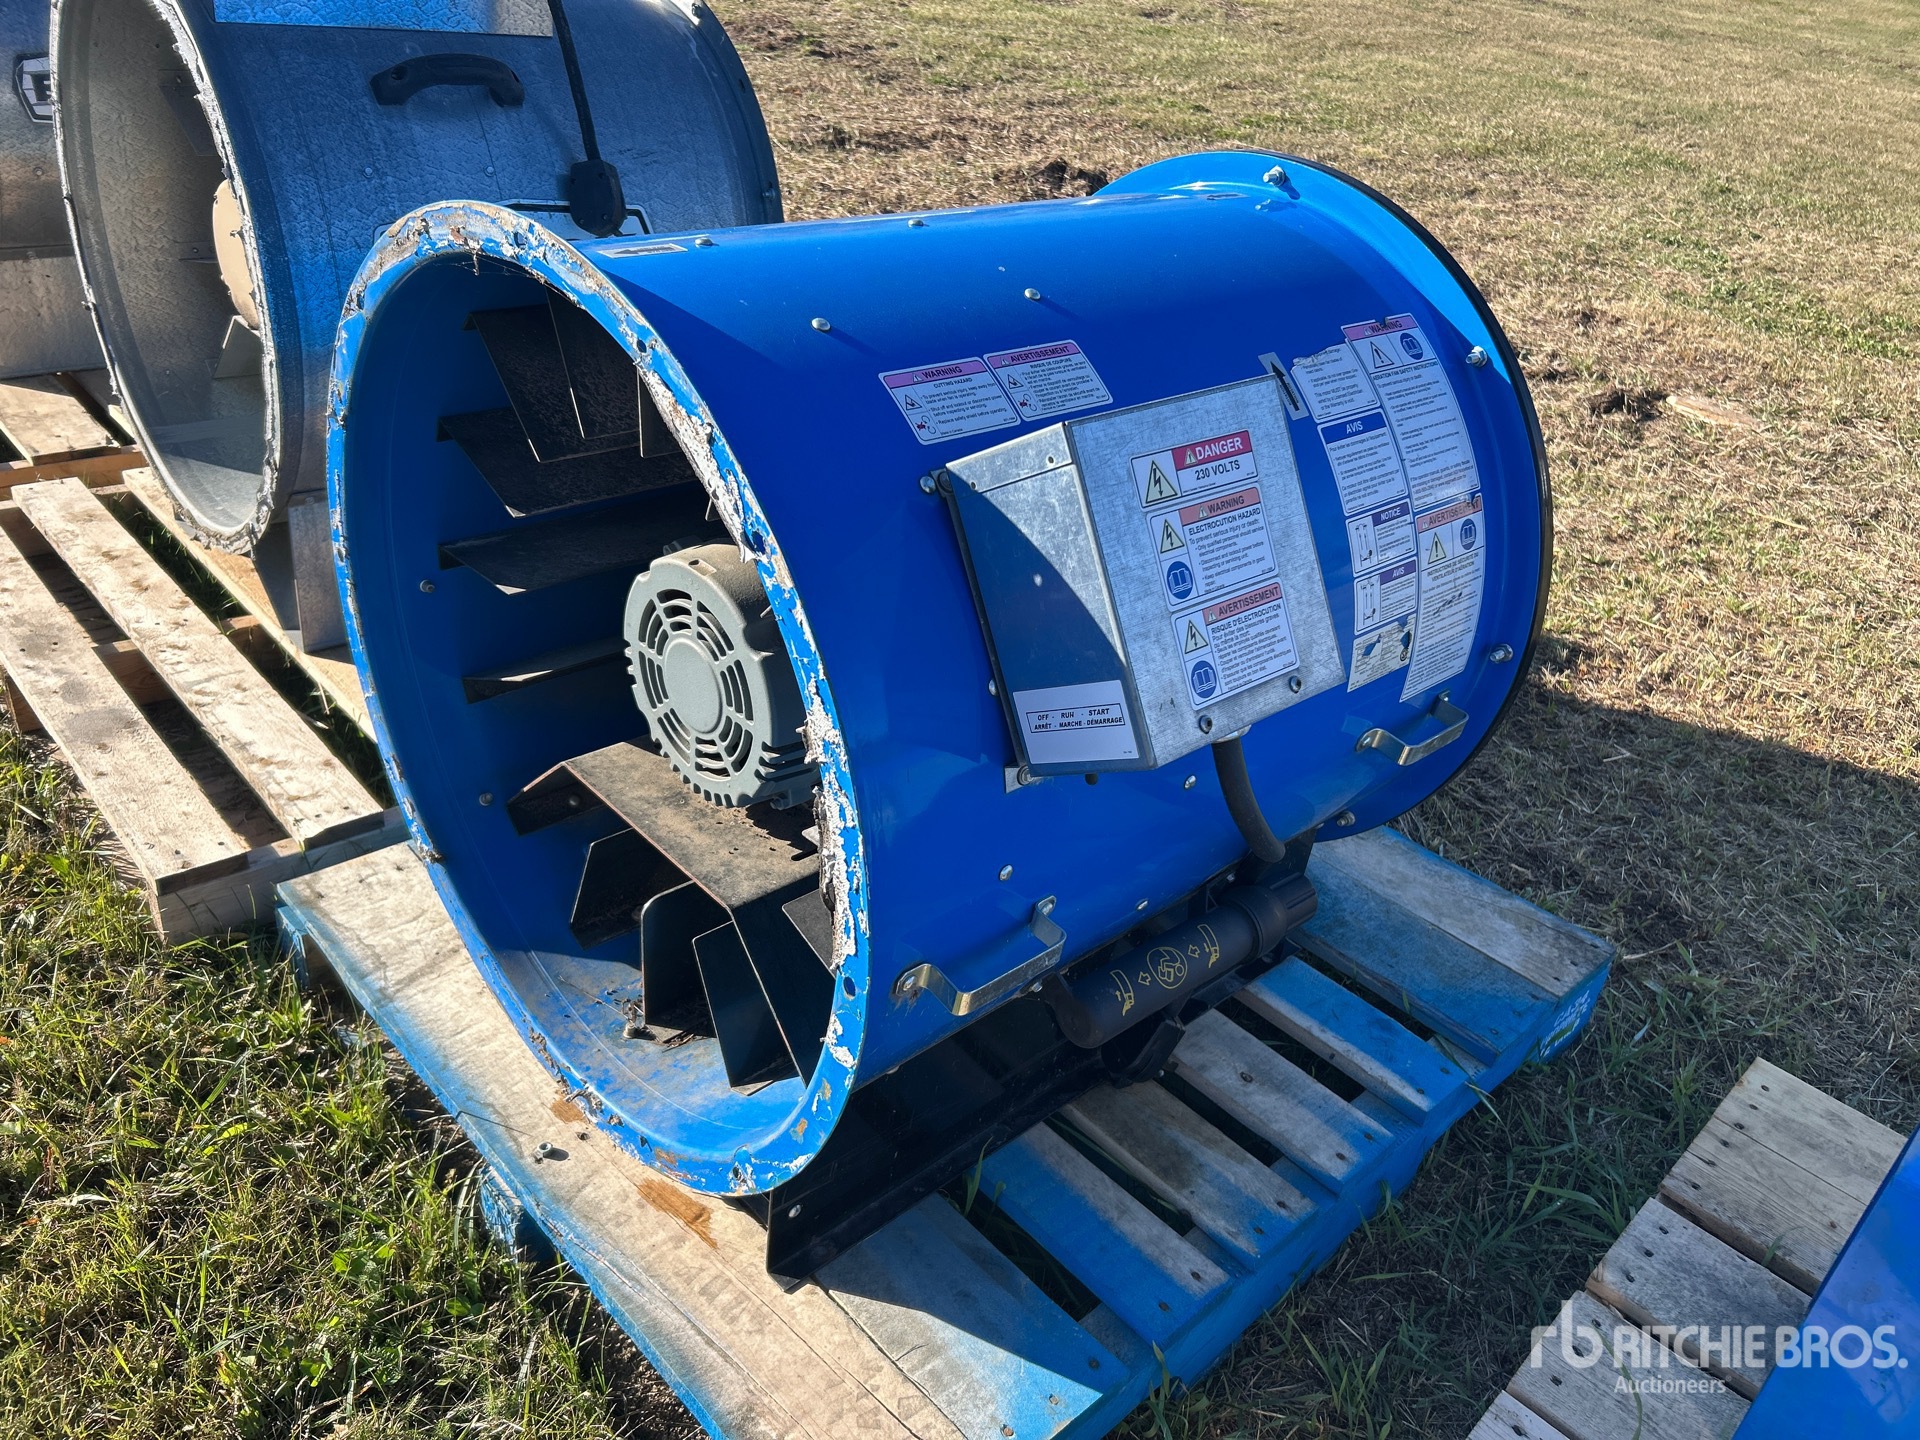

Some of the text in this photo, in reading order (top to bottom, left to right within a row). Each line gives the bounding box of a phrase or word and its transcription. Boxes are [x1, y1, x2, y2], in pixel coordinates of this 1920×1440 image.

[1010, 345, 1069, 362] AVERTISSEMENT
[921, 365, 962, 379] WARNING
[1346, 420, 1363, 434] AVIS
[1195, 437, 1243, 460] DANGER
[1194, 459, 1240, 480] 230 VOLTS
[1207, 495, 1244, 513] WARNING
[1188, 507, 1260, 536] ELECTROCUTION HAZARD
[1380, 507, 1401, 520] NOTICE
[1392, 566, 1404, 577] AVIS
[1218, 586, 1278, 616] AVERTISSEMENT
[1210, 603, 1281, 634] RISQUE D'ÉLECTROCUTION
[1037, 713, 1049, 721] OFF
[1088, 707, 1109, 716] START
[1034, 722, 1052, 730] ARRÊT
[1086, 716, 1123, 725] DÉMARRAGE
